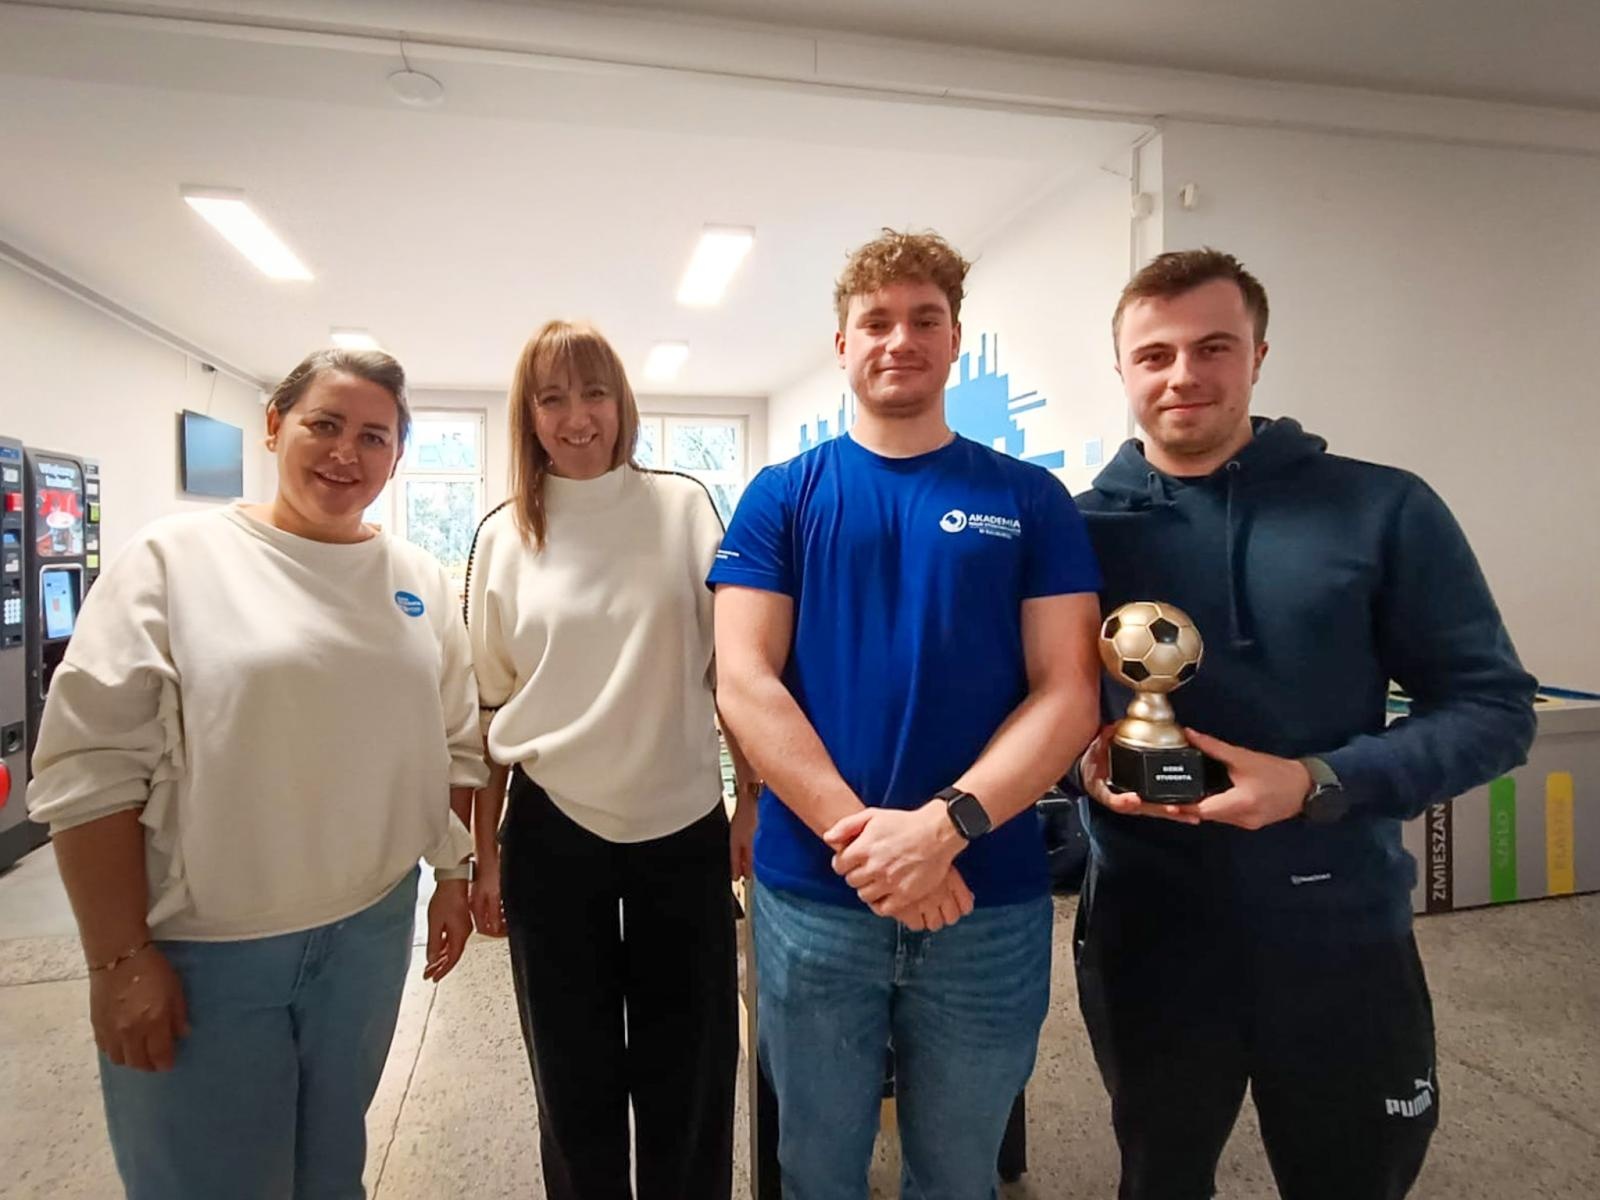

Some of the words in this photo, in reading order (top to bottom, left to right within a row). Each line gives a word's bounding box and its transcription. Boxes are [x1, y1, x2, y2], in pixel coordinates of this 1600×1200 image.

[968, 513, 1021, 529] AKADEMIA
[1432, 803, 1446, 901] ZMIESZAN
[1385, 1089, 1432, 1117] PUMA
